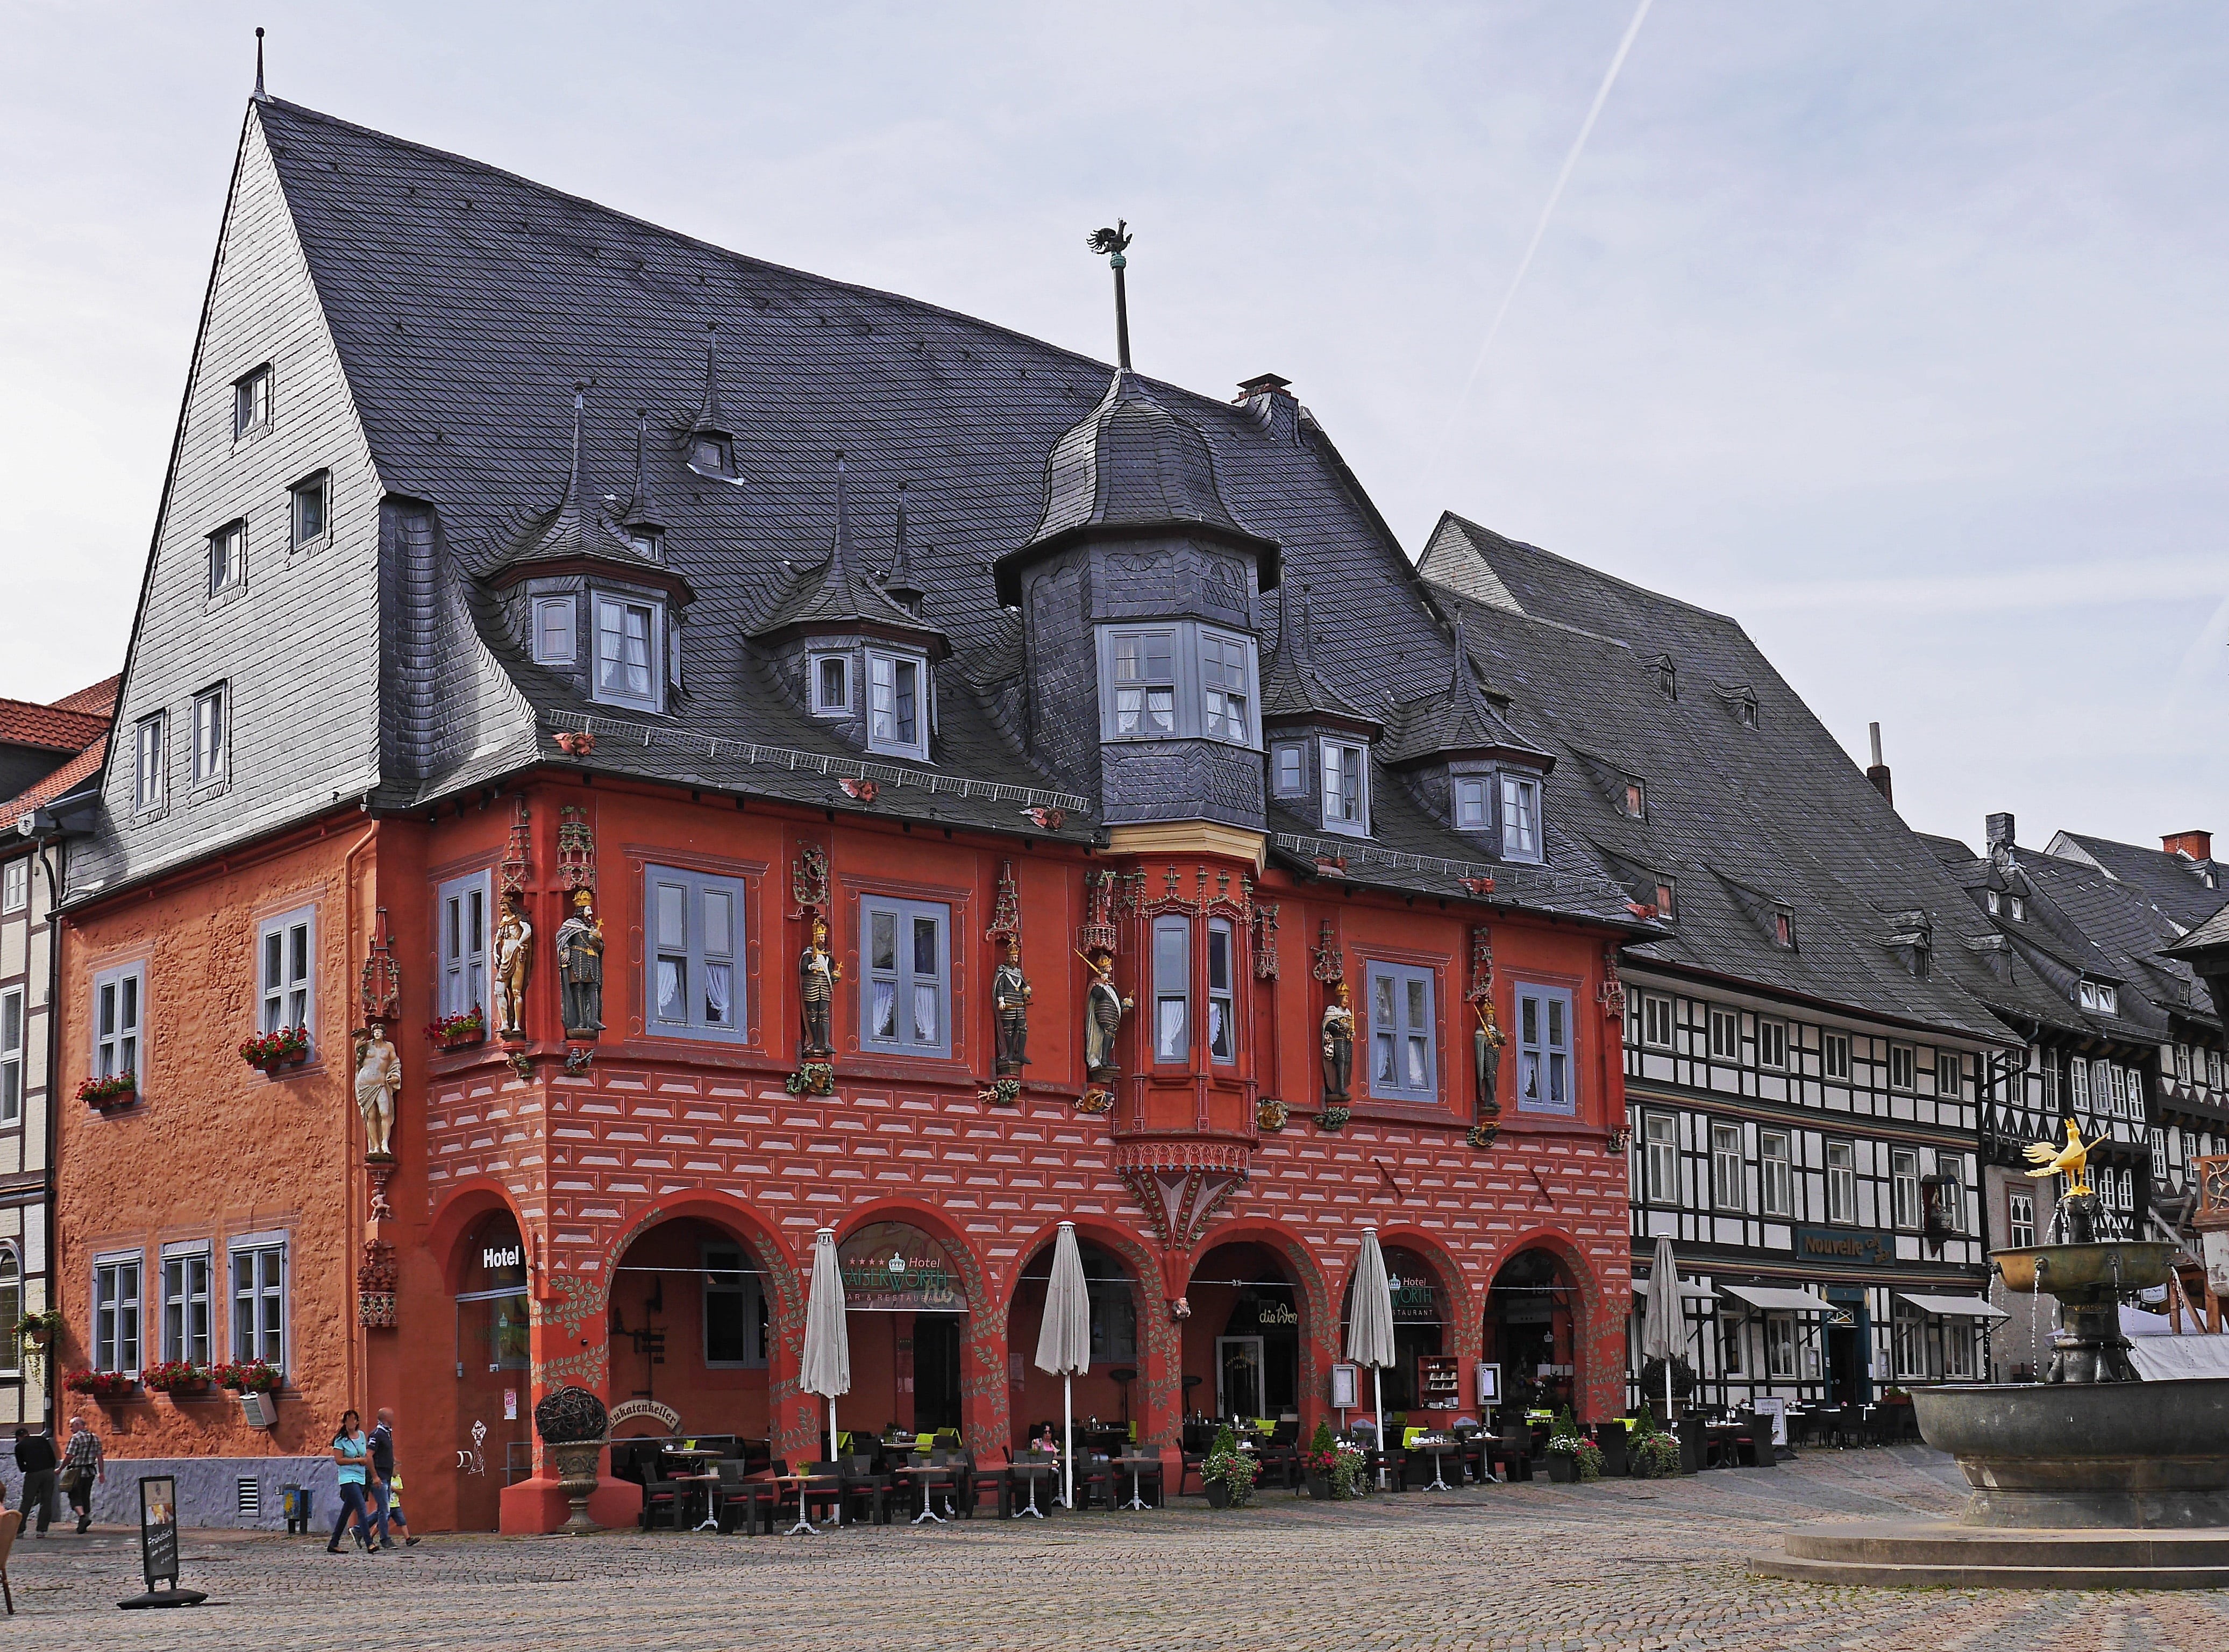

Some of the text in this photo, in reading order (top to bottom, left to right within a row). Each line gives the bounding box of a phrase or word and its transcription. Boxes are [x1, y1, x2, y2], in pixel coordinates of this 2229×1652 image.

[483, 1245, 519, 1268] Hotel
[1805, 1236, 1863, 1256] Nouvelle
[909, 1257, 941, 1268] Hotel
[841, 1268, 947, 1292] KAISERWORTH
[1403, 1277, 1427, 1286] Hotel
[1259, 1303, 1298, 1325] die Wor
